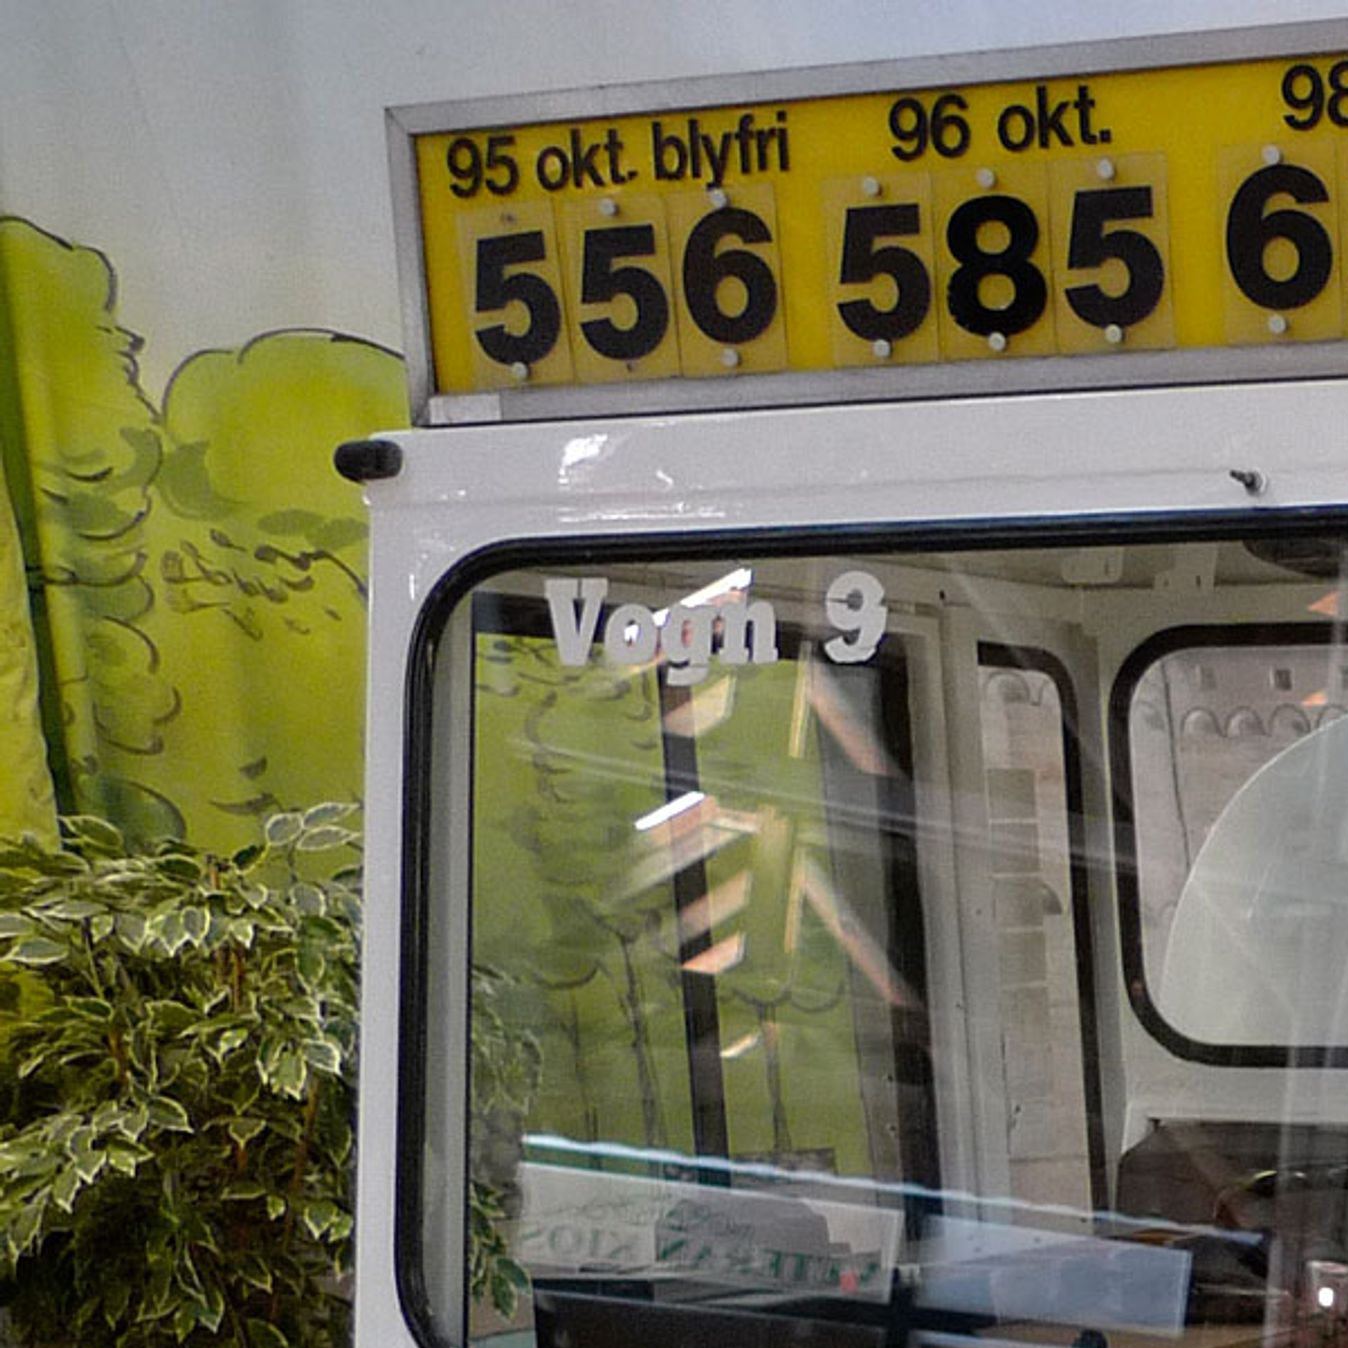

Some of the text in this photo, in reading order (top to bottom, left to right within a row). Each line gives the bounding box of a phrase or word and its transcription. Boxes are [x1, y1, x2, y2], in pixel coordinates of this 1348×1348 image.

[446, 110, 791, 200] 95 okt. blyfri
[889, 85, 1112, 162] 96 okt.
[474, 207, 778, 368] 556
[836, 186, 1165, 346] 585
[544, 570, 889, 687] Vogn 9
